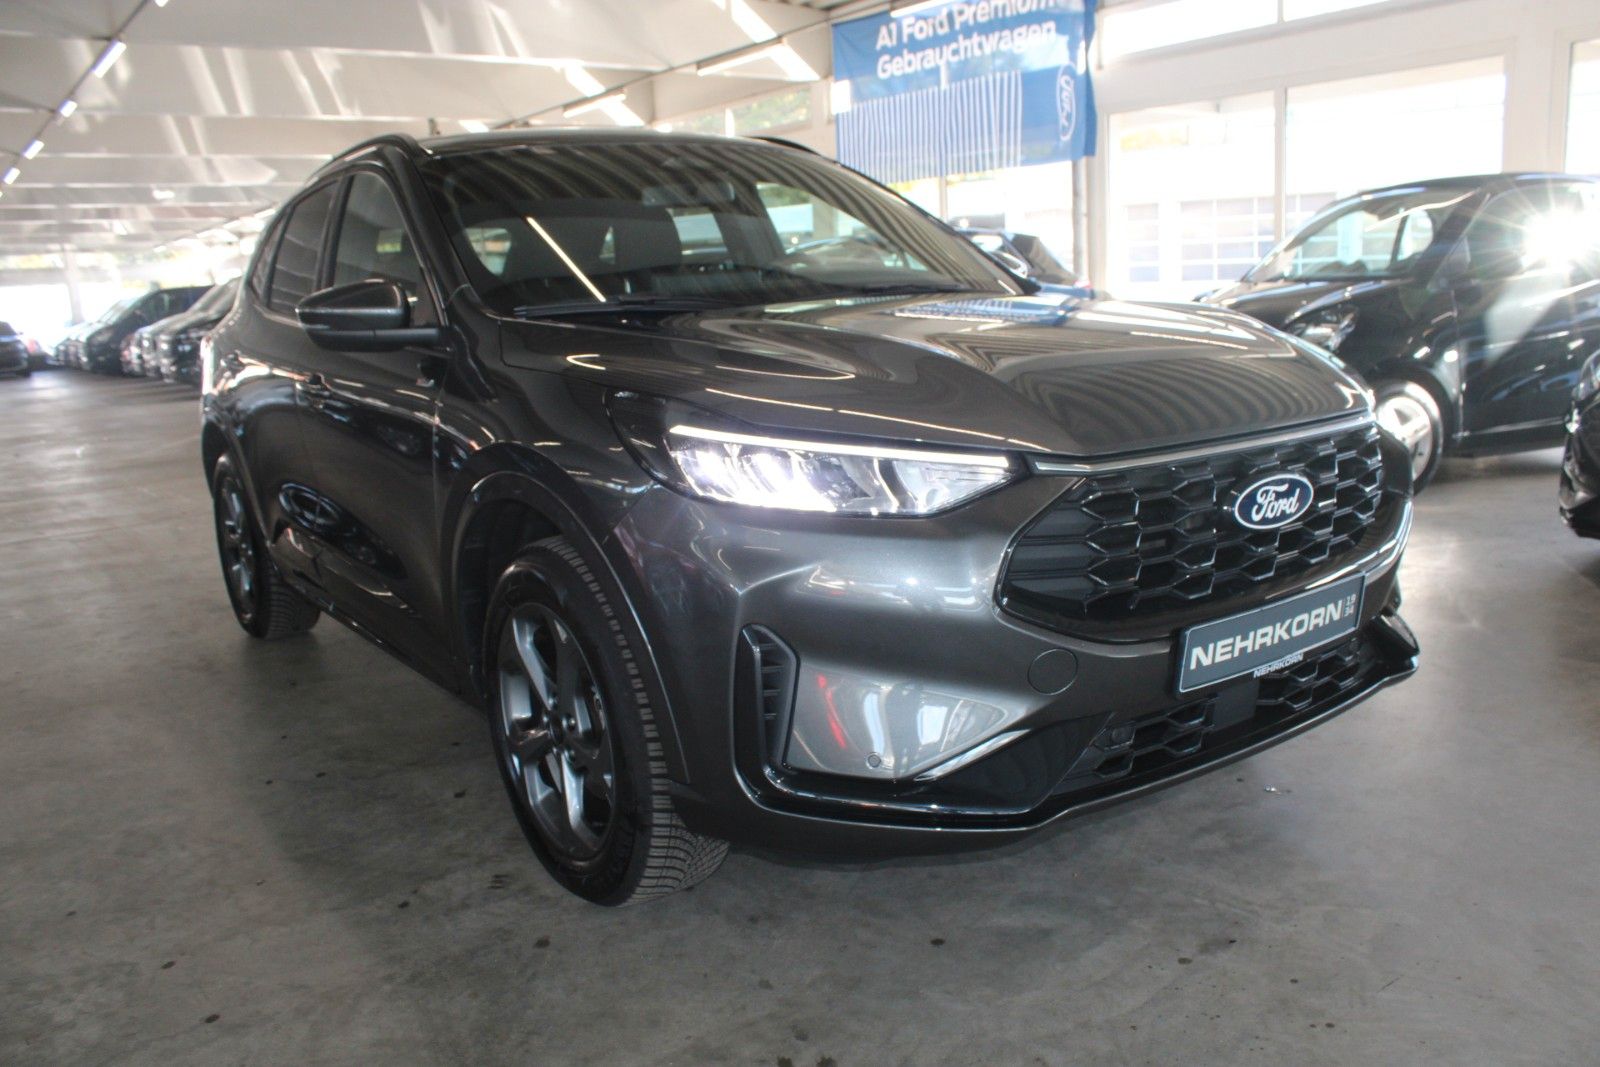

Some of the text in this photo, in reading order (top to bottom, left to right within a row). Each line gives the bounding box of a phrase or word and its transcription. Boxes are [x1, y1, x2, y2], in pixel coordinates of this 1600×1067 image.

[902, 7, 950, 44] Ford
[876, 20, 1056, 80] Gebrauchtwagen
[1251, 483, 1301, 522] Ford
[1189, 599, 1343, 671] NEHRKORN
[1253, 652, 1304, 679] NEHRKORN
